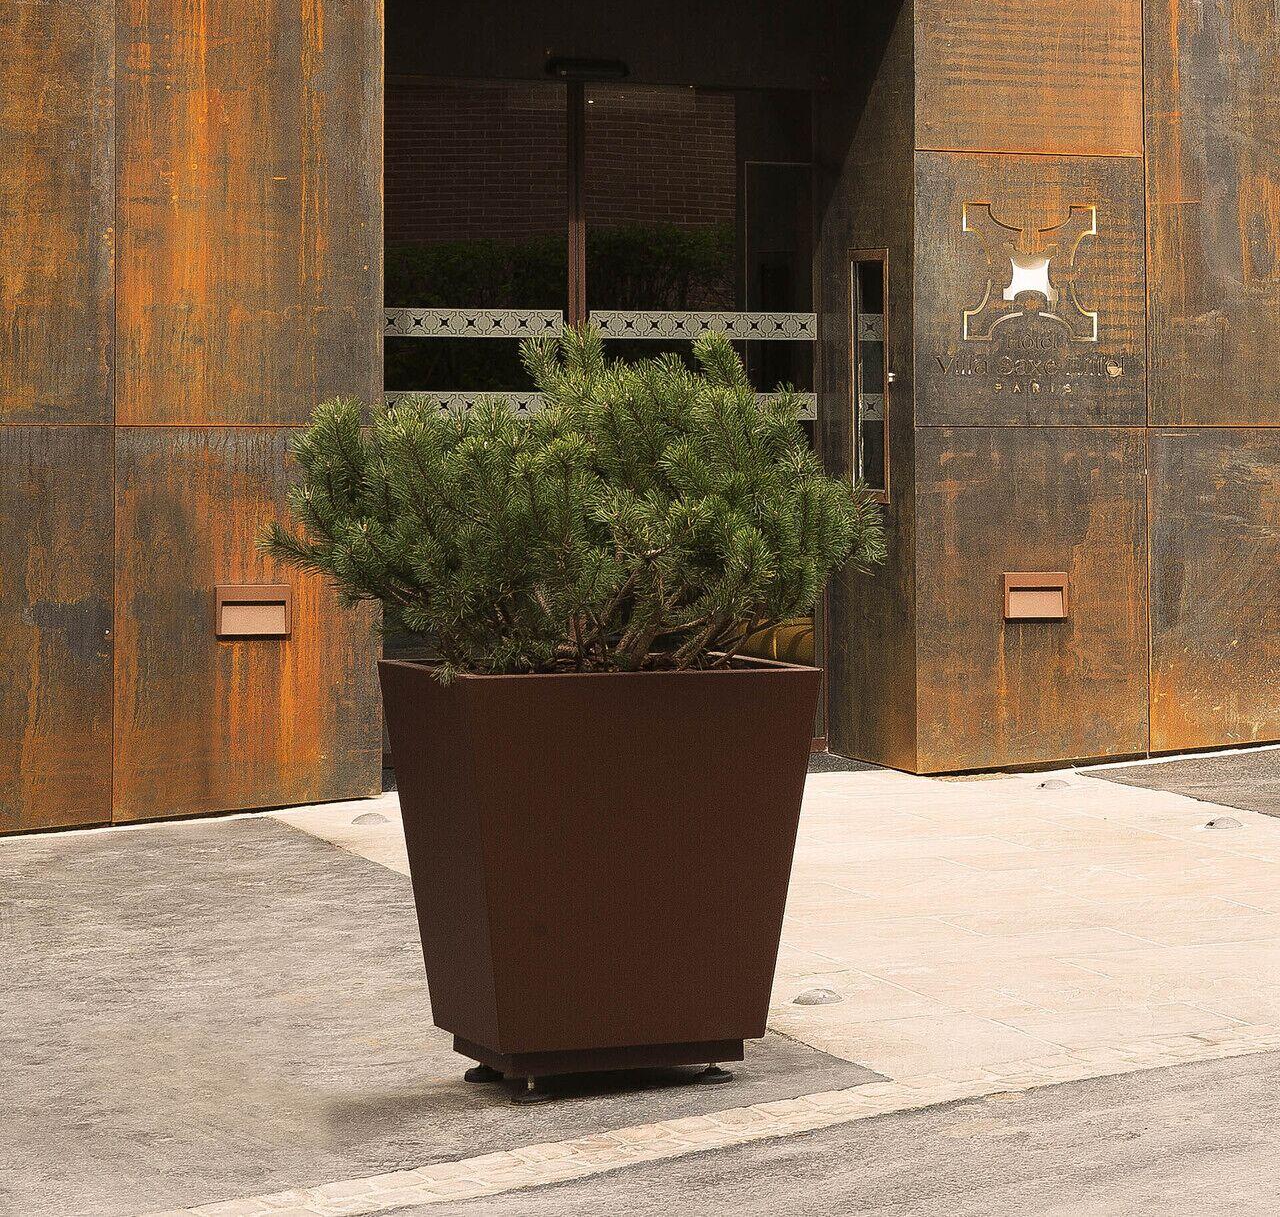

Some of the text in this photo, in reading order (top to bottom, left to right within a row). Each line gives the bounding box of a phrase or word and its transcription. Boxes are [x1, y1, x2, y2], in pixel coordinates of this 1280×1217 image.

[935, 354, 989, 376] Villa
[997, 355, 1059, 376] Saxe
[994, 382, 1073, 394] PARIS
